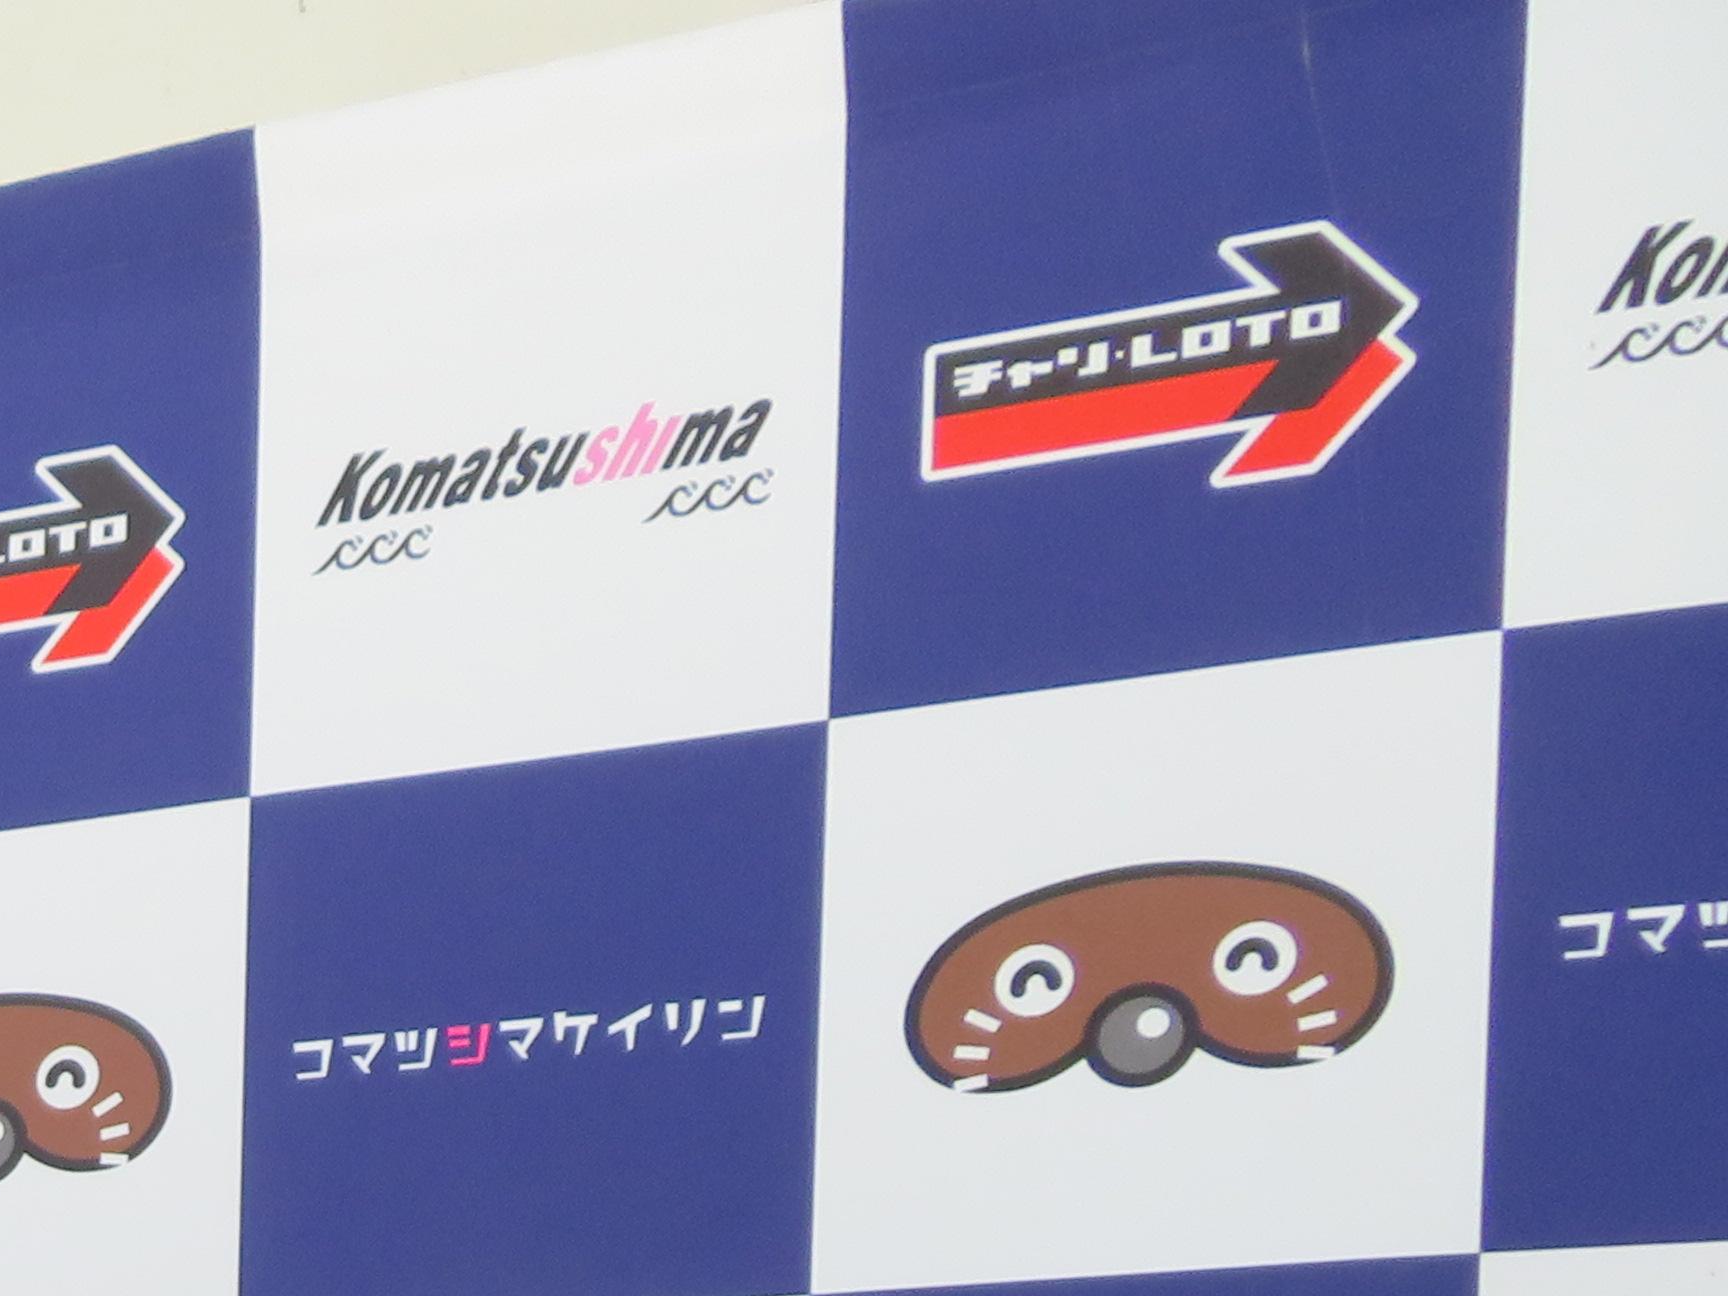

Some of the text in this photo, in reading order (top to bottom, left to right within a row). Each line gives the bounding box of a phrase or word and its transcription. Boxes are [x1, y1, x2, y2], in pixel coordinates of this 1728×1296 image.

[317, 401, 770, 526] Komatsushima
[291, 996, 766, 1081] コマツシマケイリン
